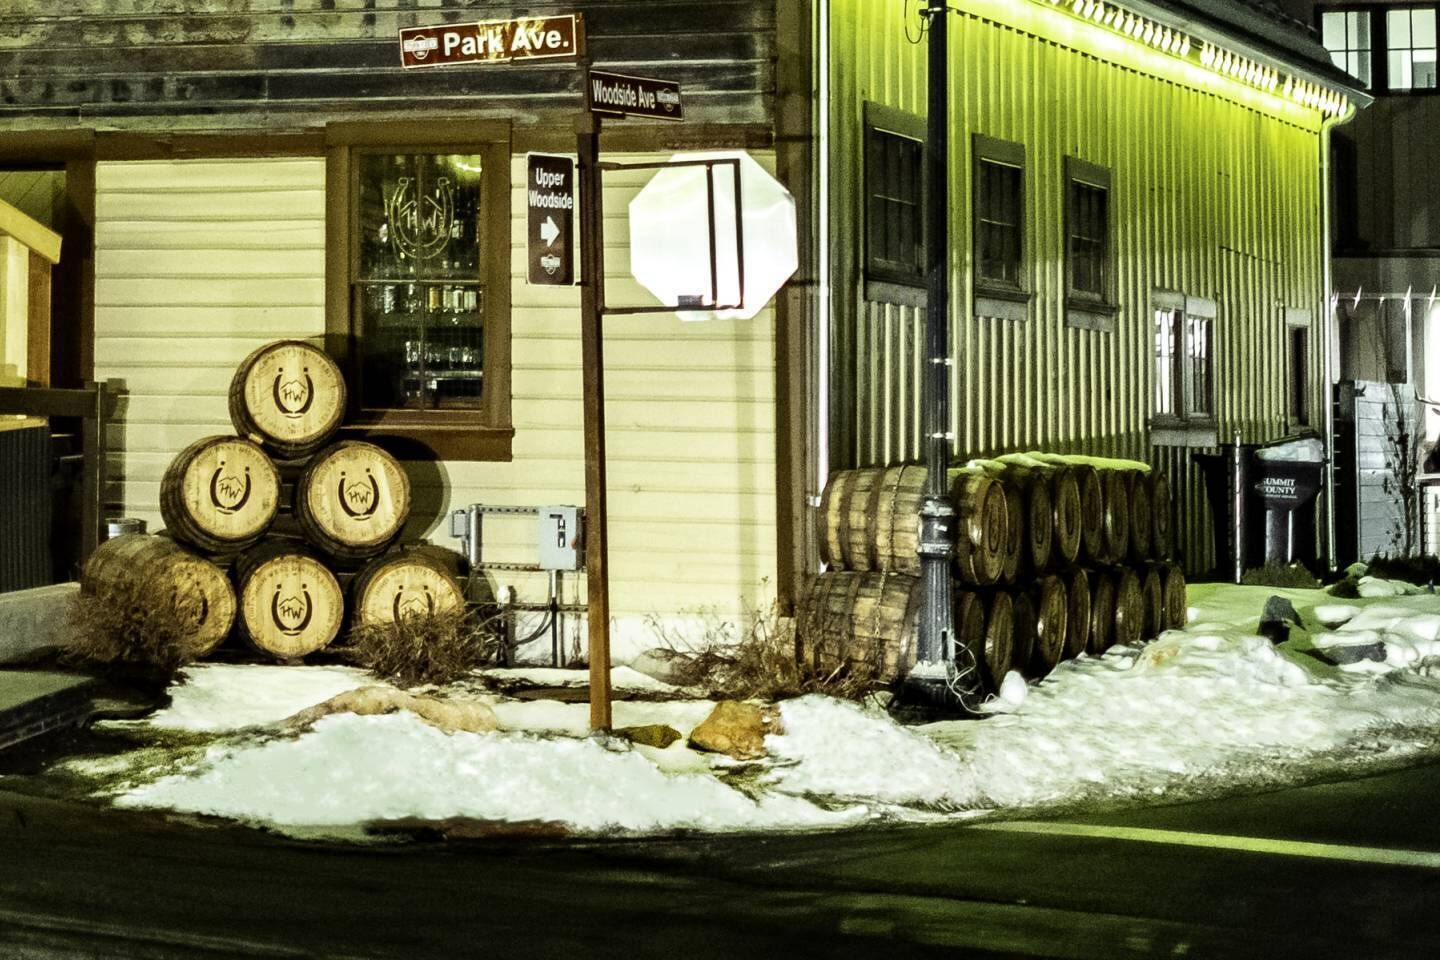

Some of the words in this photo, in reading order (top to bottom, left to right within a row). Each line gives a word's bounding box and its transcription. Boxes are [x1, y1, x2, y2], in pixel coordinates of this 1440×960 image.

[443, 30, 505, 57] Park
[511, 26, 569, 53] Ave.
[592, 79, 637, 108] Woodside
[638, 85, 656, 110] Ave
[535, 167, 565, 189] Upper
[528, 189, 574, 210] Woodside
